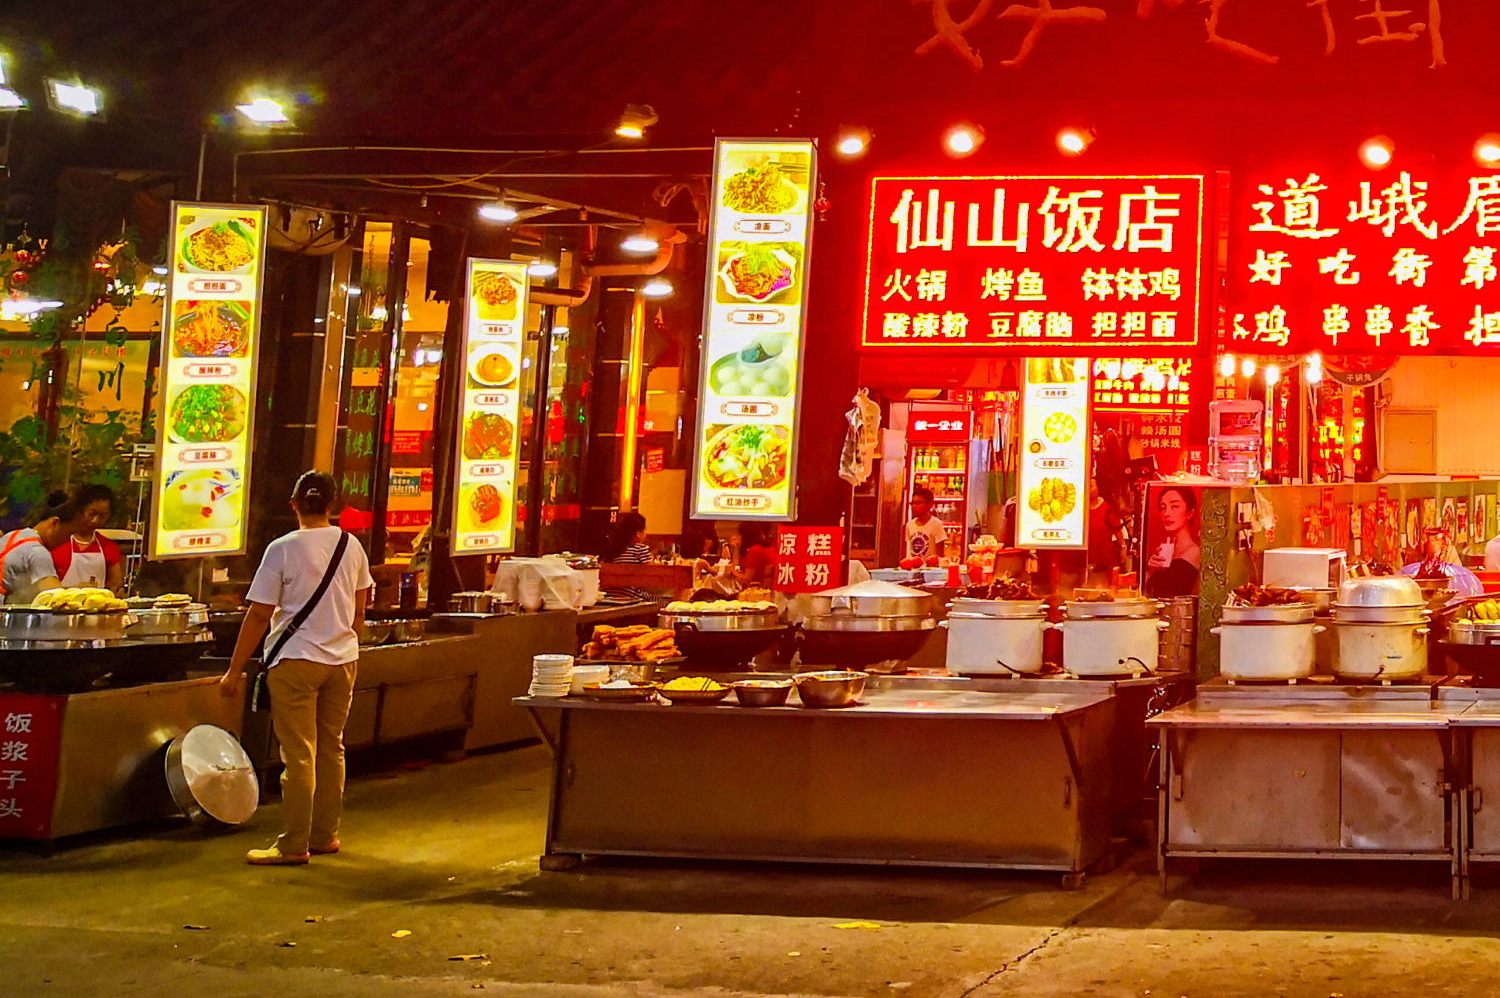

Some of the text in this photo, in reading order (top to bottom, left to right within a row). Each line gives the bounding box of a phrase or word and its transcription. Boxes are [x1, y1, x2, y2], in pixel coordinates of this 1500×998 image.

[890, 186, 1181, 253] 仙山饭店
[881, 267, 1181, 301] 火锅 烤鱼 钵钵鸡
[1091, 311, 1178, 337] 担担面
[1323, 304, 1440, 347] 串串香
[779, 533, 832, 556] 凉糕
[777, 562, 830, 586] 冰粉
